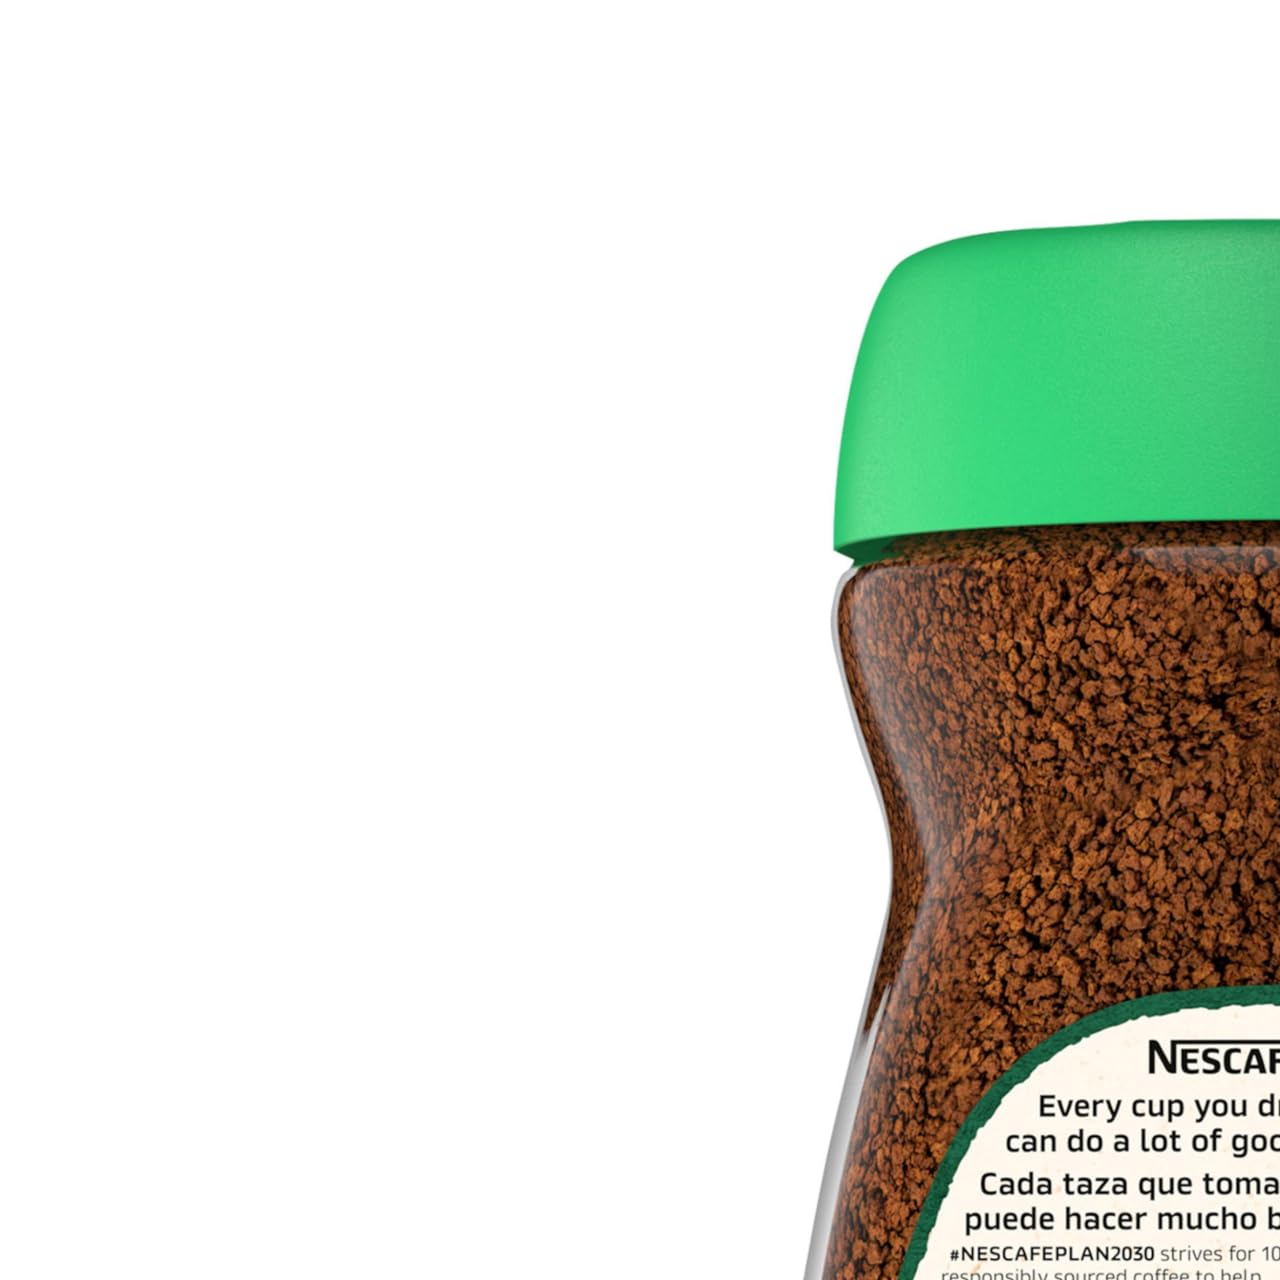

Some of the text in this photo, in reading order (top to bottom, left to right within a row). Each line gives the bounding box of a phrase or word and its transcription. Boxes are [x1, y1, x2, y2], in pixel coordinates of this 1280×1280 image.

[1039, 1094, 1122, 1124] Every
[1132, 1099, 1184, 1123] cup
[1194, 1099, 1247, 1123] you
[1006, 1134, 1056, 1153] can
[1067, 1128, 1103, 1153] do
[1113, 1134, 1129, 1153] a
[1141, 1128, 1182, 1152] lot
[1192, 1127, 1223, 1152] of
[980, 1171, 1052, 1196] Cada
[1062, 1173, 1128, 1196] taza
[1138, 1177, 1193, 1201] que
[965, 1206, 1055, 1236] puede
[1065, 1206, 1148, 1230] hacer
[1158, 1206, 1257, 1230] mucho
[950, 1246, 1155, 1262] #NESCAFEPLAN2030
[1160, 1245, 1223, 1262] strives
[1229, 1245, 1255, 1262] for
